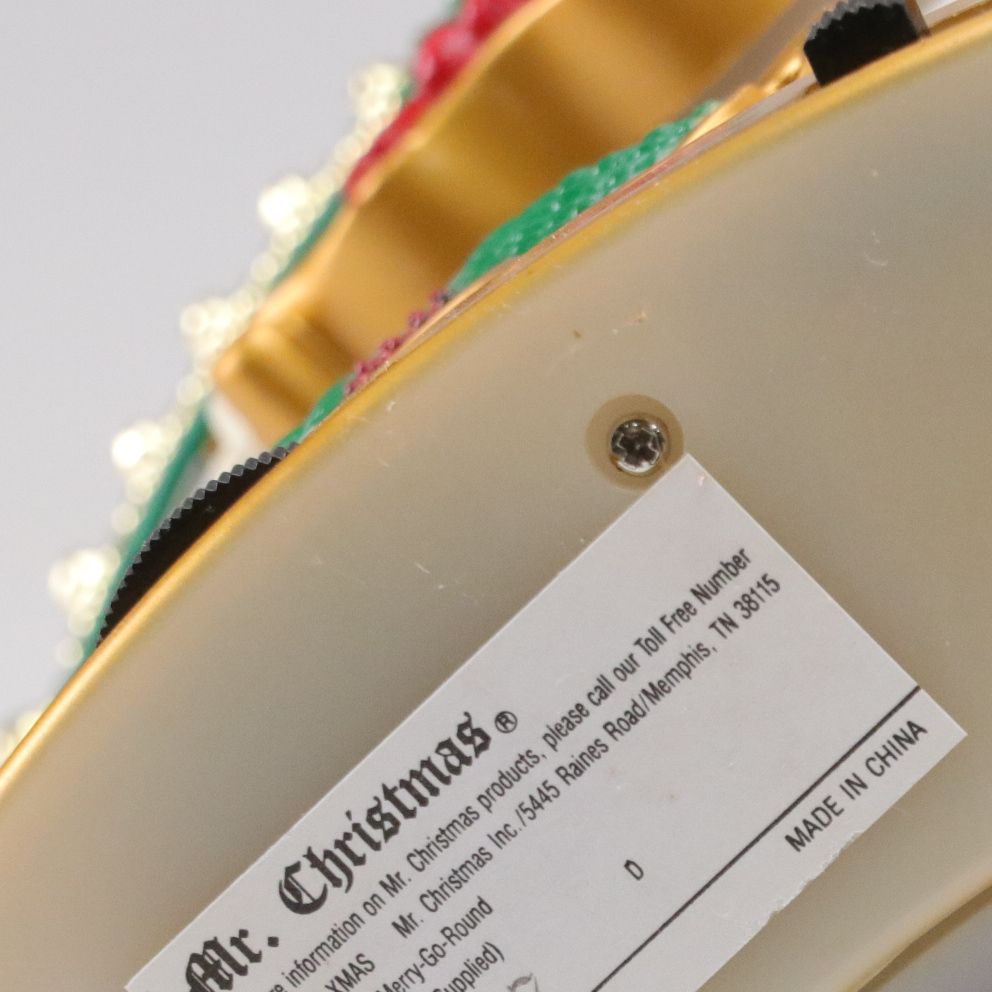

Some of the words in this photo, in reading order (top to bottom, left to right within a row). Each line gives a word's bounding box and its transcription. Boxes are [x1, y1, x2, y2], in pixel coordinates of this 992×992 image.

[282, 913, 365, 987] information
[363, 894, 385, 916] on
[379, 872, 411, 897] Mr.
[407, 806, 480, 872] Christmas
[477, 750, 546, 813] products,
[542, 703, 590, 752] please
[587, 674, 615, 706] call
[613, 653, 640, 681] our
[634, 626, 667, 656] Toll
[660, 601, 697, 633] Free
[690, 549, 750, 605] Number
[392, 913, 418, 938] Mr.
[419, 847, 493, 912] Christmas
[487, 780, 560, 849] Inc./5445
[555, 739, 609, 785] Raines
[603, 643, 716, 741] Road/Memphis,
[709, 612, 739, 638] TN
[733, 574, 780, 619] 38115
[785, 795, 844, 852] MADE
[840, 773, 868, 800] IN
[865, 721, 927, 777] CHINA
